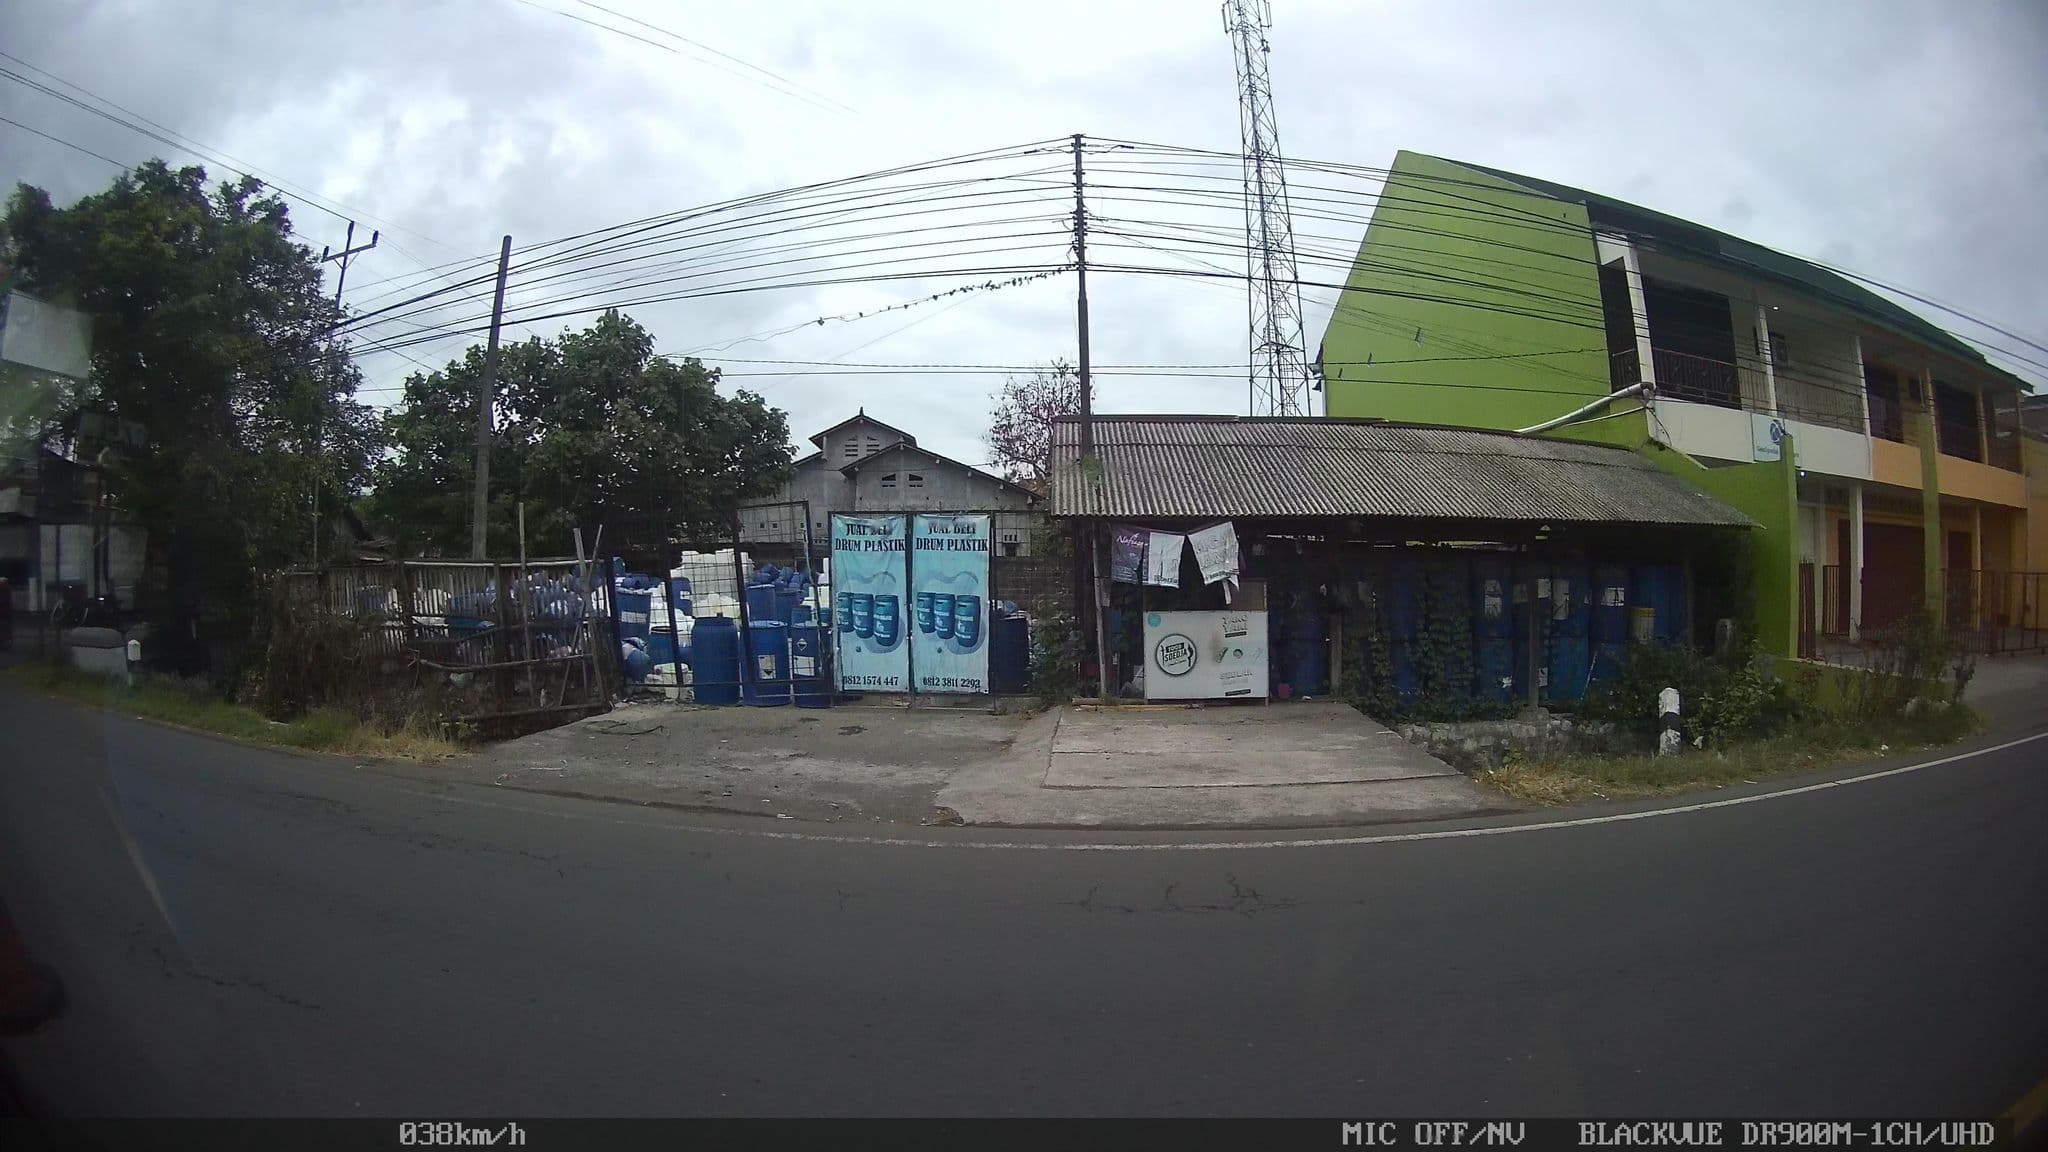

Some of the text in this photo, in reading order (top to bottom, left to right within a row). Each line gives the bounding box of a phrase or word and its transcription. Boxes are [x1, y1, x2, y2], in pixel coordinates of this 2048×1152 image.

[835, 538, 905, 552] DRUM PLASTIK
[916, 537, 988, 552] DRUM PLASTIK
[862, 675, 882, 687] 1574
[884, 676, 899, 687] 447
[923, 676, 940, 687] 0812
